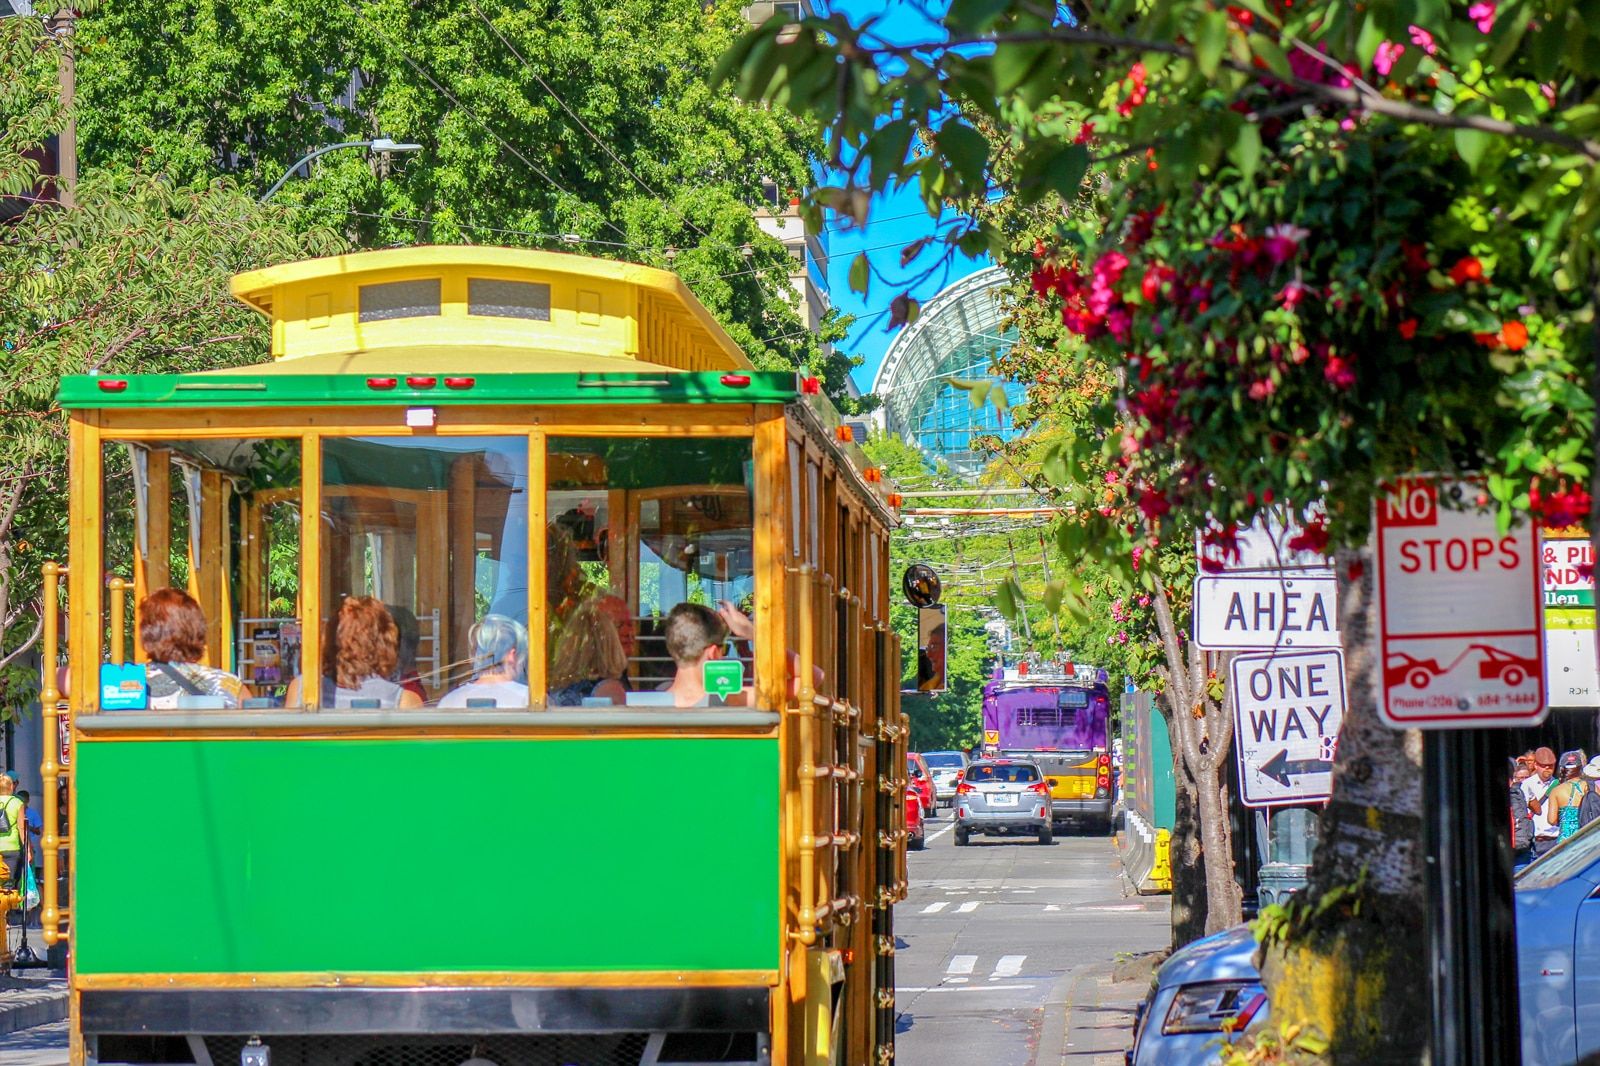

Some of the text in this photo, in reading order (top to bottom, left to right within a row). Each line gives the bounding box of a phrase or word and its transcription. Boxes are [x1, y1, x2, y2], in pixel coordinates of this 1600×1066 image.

[1386, 487, 1431, 520] NO
[1400, 536, 1520, 574] STOPS
[1224, 591, 1341, 631] AHEA
[1249, 664, 1329, 701] ONE
[1249, 704, 1332, 743] WAY
